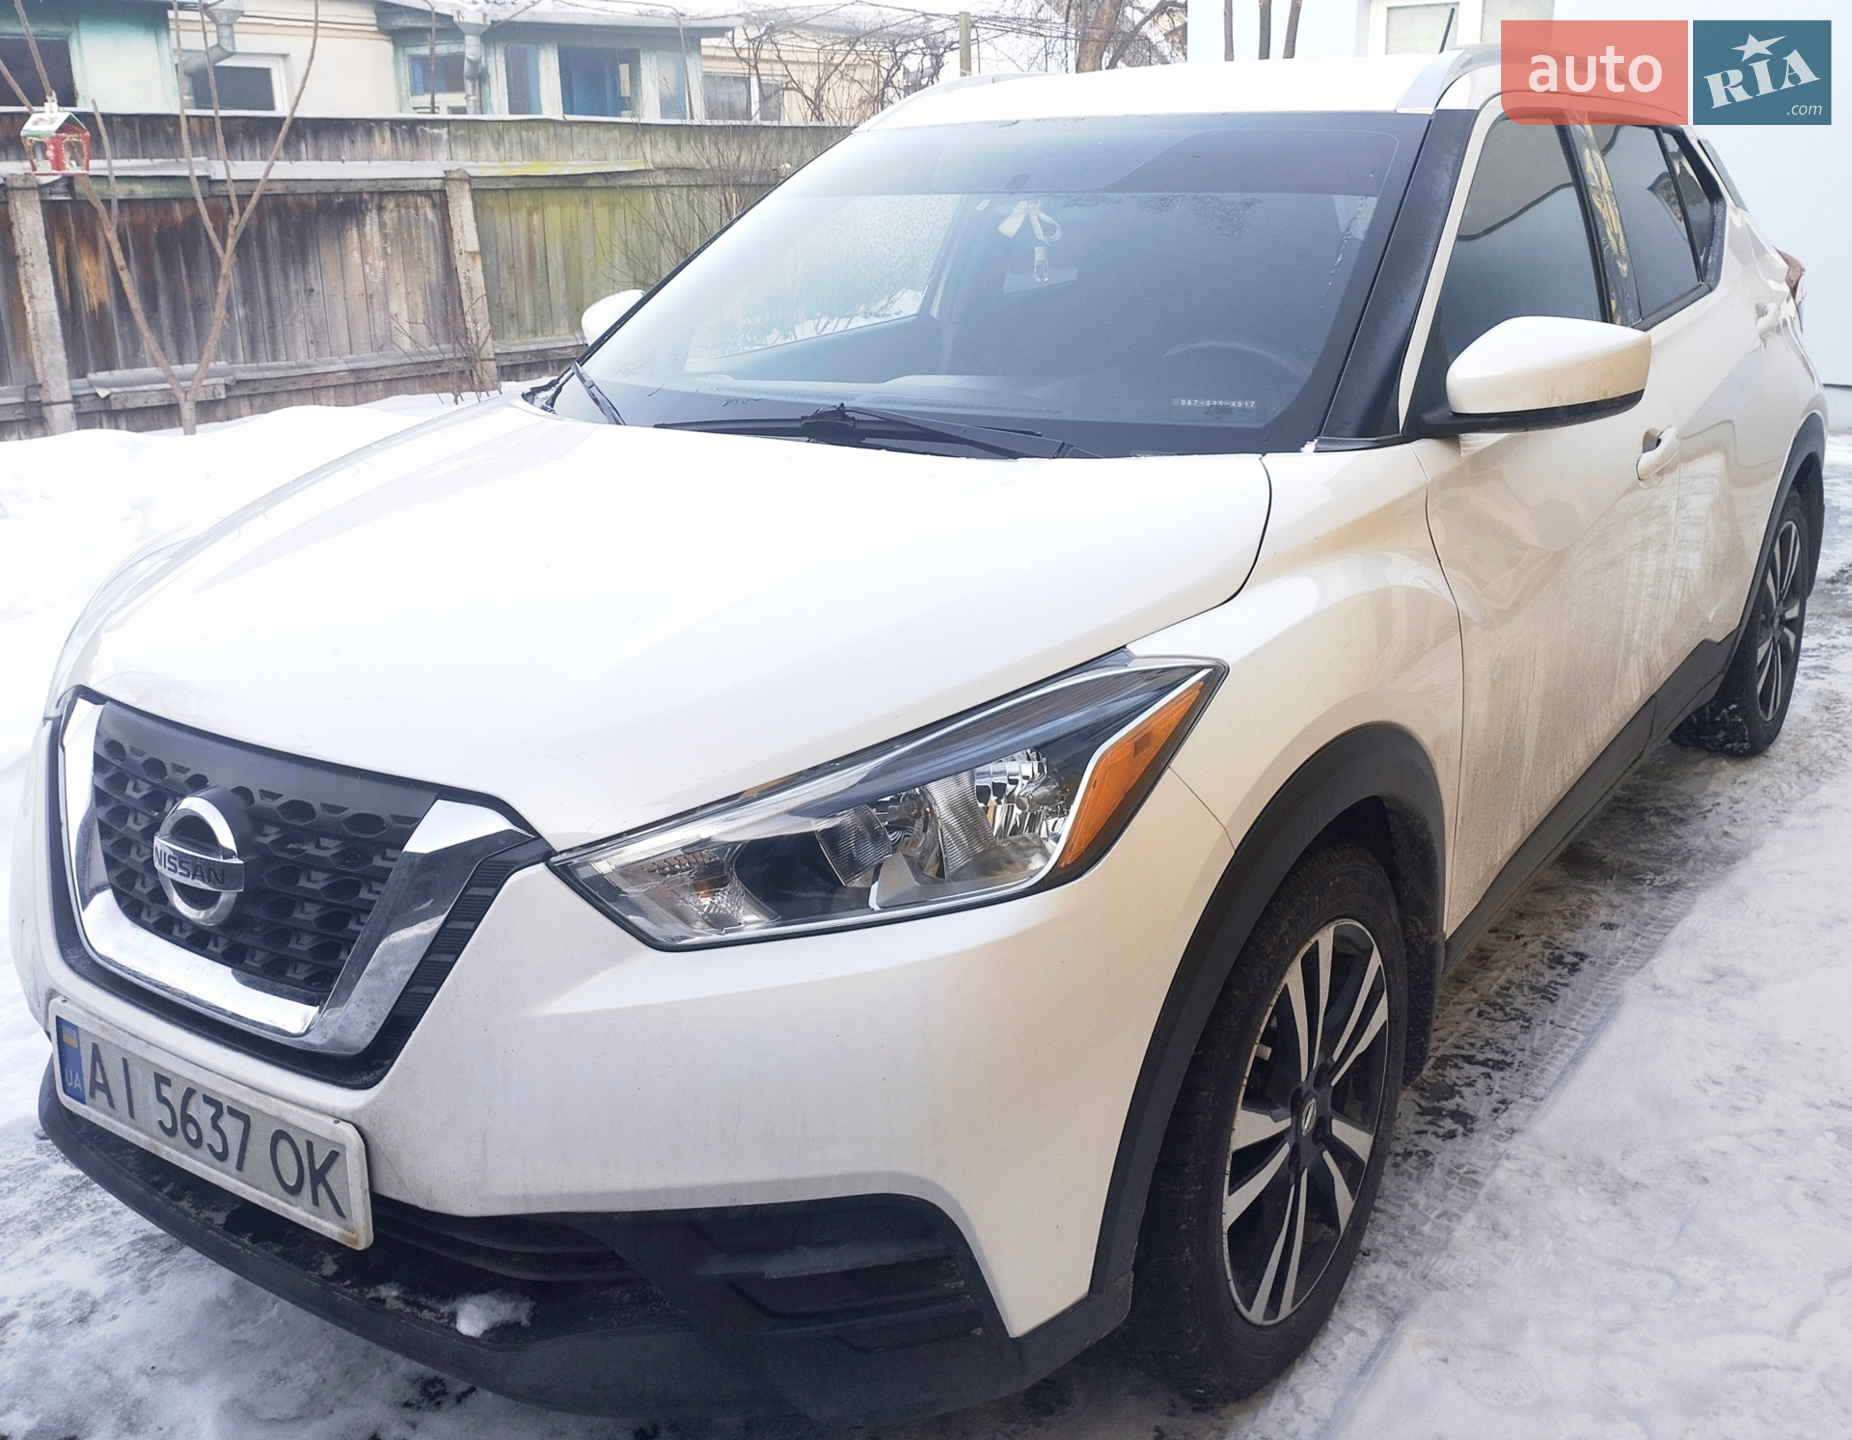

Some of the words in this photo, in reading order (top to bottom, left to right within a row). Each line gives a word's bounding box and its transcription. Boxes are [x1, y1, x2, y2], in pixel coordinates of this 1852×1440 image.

[155, 846, 225, 885] NISSAN
[65, 1068, 83, 1092] UA
[89, 1041, 135, 1120] AI
[153, 1071, 251, 1173] 5637
[270, 1128, 346, 1219] OK
